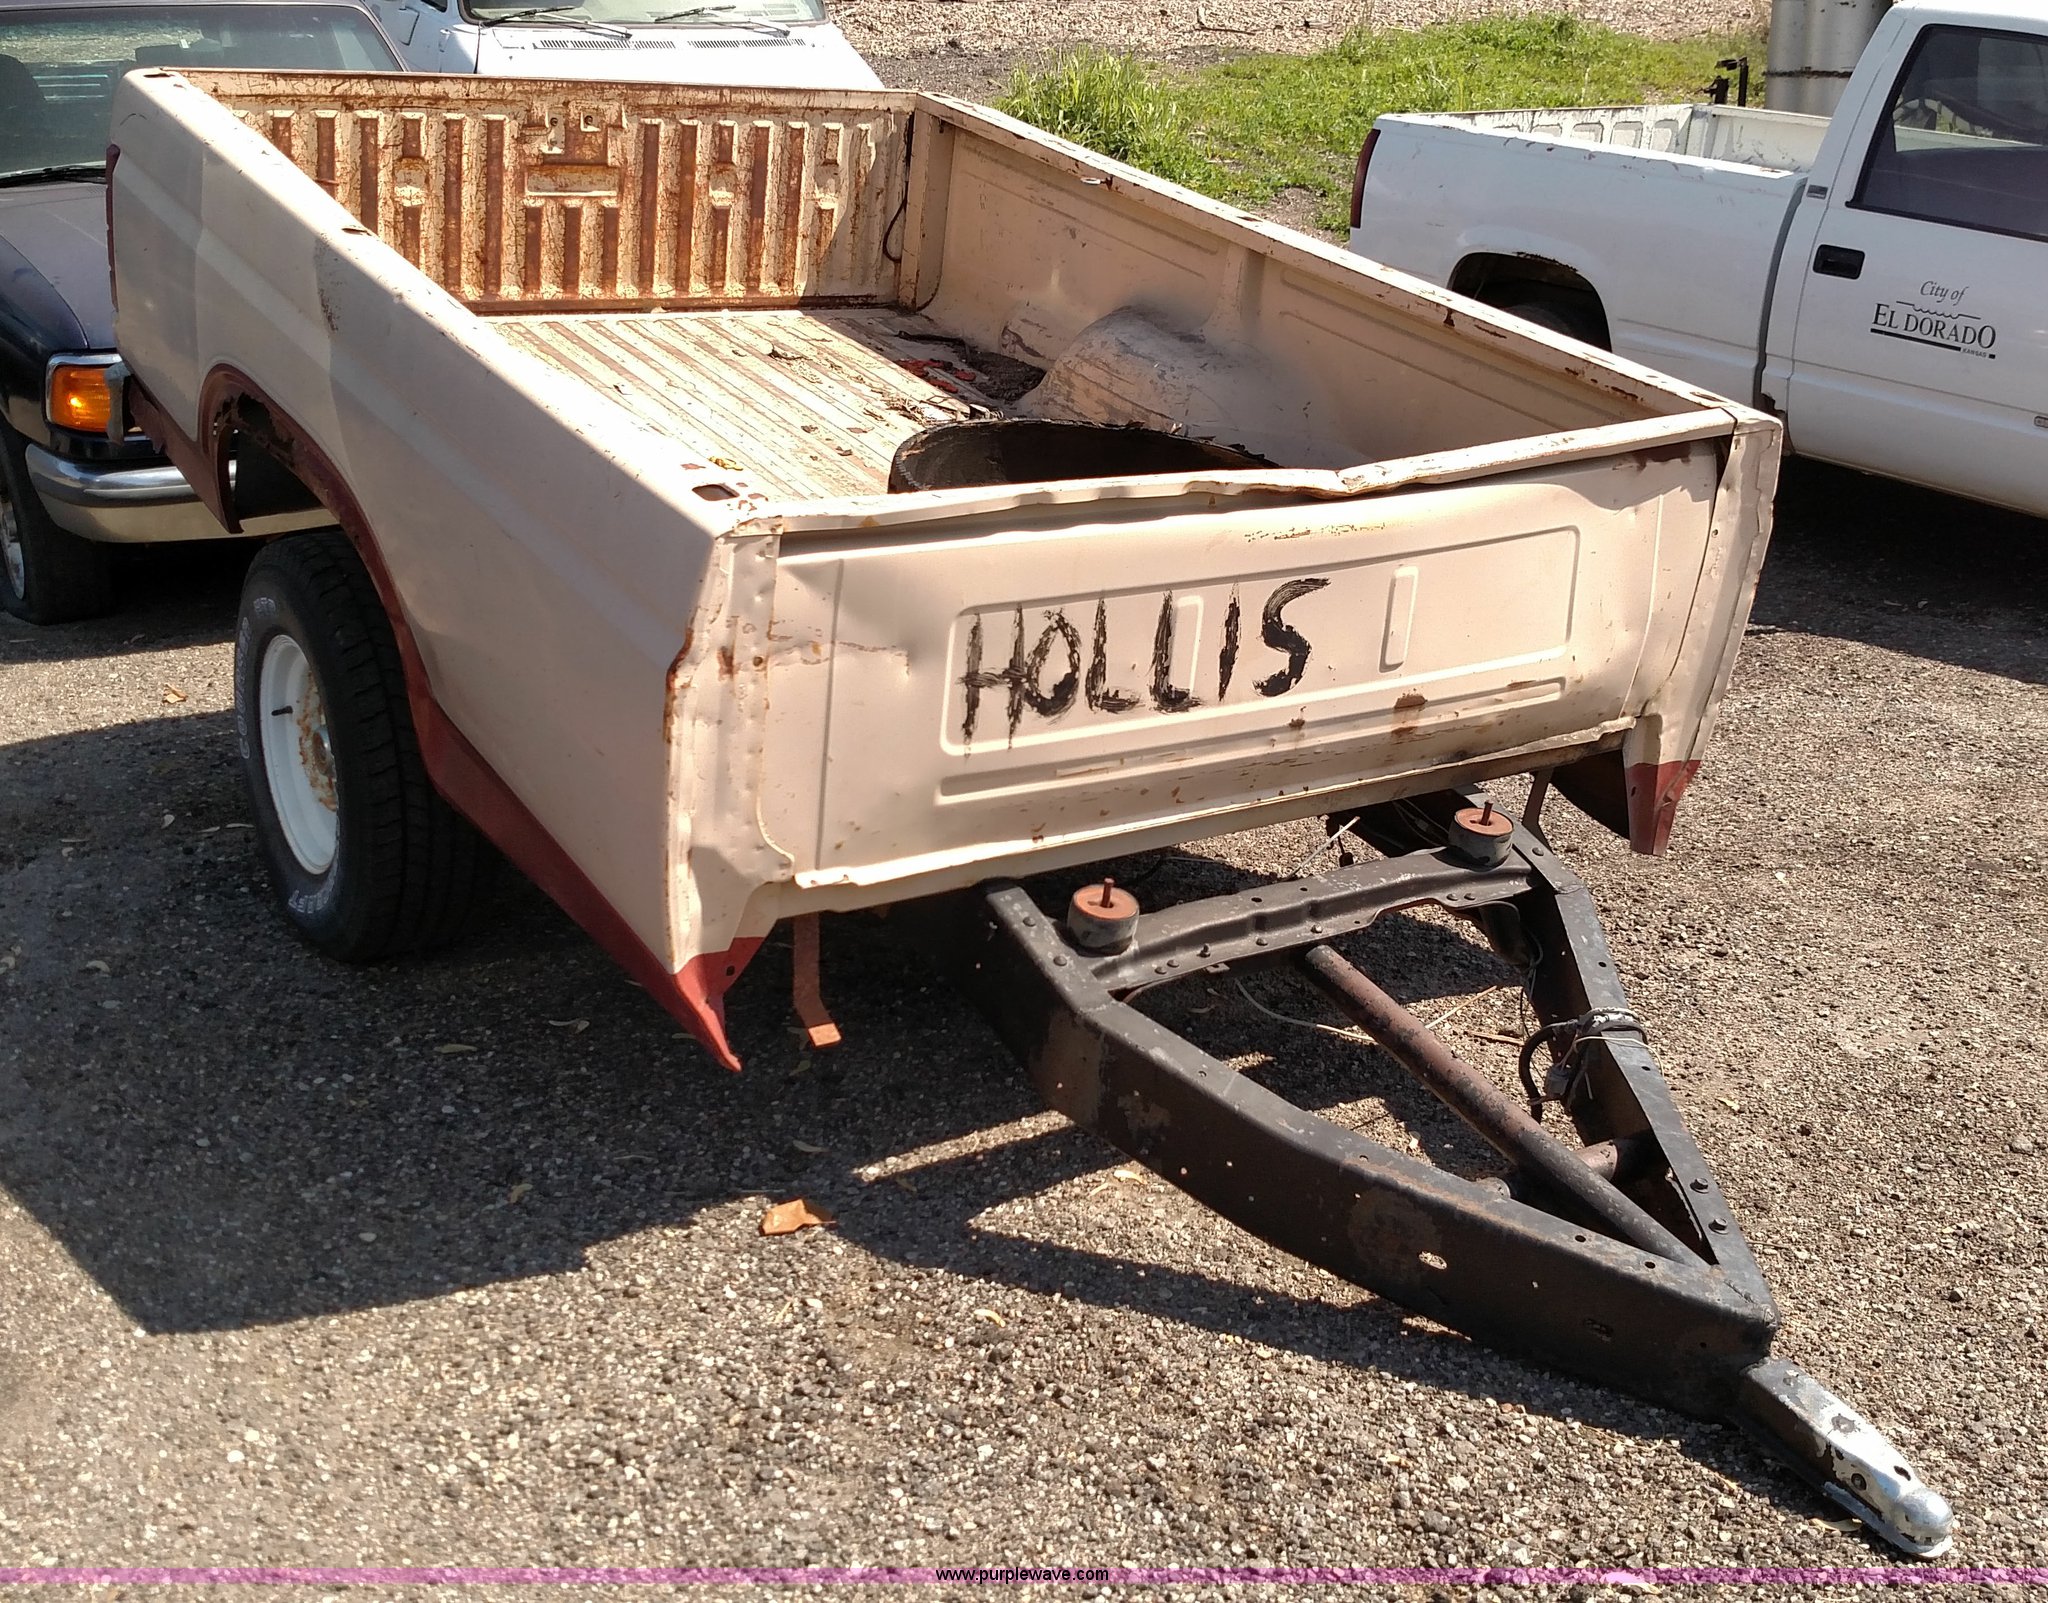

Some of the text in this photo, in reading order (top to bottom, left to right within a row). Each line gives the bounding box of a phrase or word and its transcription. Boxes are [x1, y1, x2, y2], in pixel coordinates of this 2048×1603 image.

[1920, 280, 1970, 306] City of
[1872, 303, 1996, 349] EL DORADO
[957, 576, 1332, 756] HOLLIS
